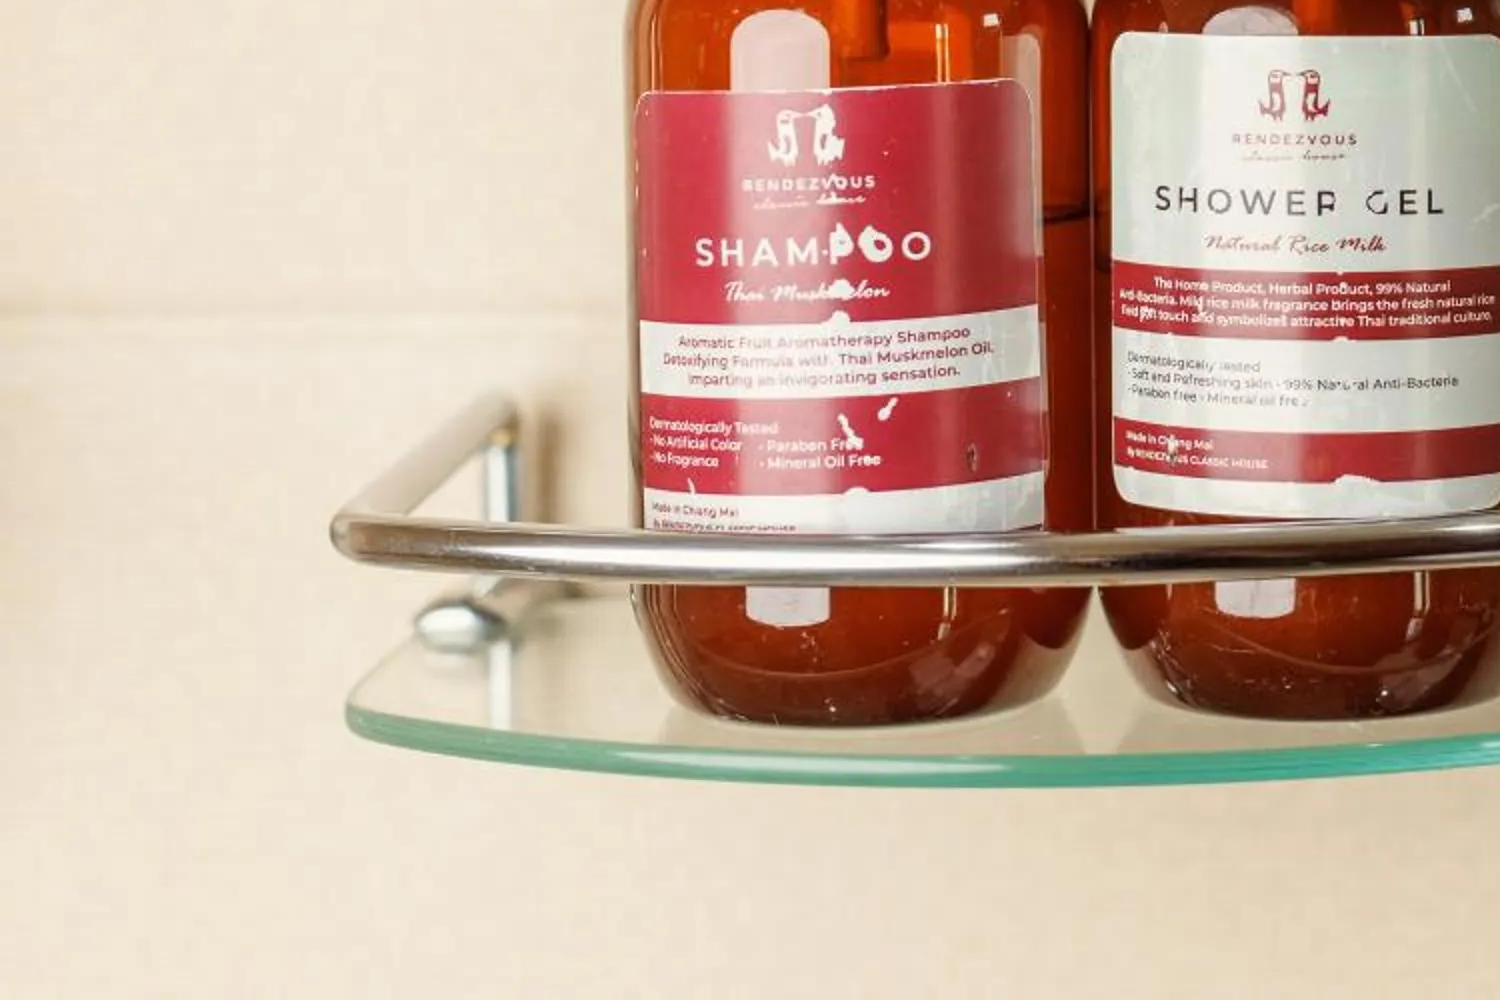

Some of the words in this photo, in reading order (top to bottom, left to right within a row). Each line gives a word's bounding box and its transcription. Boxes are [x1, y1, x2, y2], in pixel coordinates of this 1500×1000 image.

[1232, 132, 1357, 146] RENDEZVOUS
[742, 174, 876, 192] RENDEZVOUS
[1155, 185, 1337, 216] SHOWER
[1366, 188, 1444, 216] GEL
[695, 226, 932, 267] SHAMPOO
[1204, 233, 1283, 252] Natural
[1287, 233, 1331, 255] Rice
[1335, 234, 1387, 253] Milk
[724, 280, 764, 301] Thai
[773, 278, 890, 300] Muskelon
[1154, 276, 1173, 289] The
[1175, 278, 1209, 292] Home
[1269, 282, 1313, 296] Herbal
[1375, 282, 1403, 296] 99%
[1406, 279, 1451, 294] Natural
[1206, 297, 1229, 309] rice
[1231, 297, 1260, 310] milk
[1263, 298, 1329, 313] fragrance
[1376, 298, 1399, 311] the
[1401, 297, 1435, 310] fresh
[1436, 293, 1476, 308] natural
[1158, 307, 1189, 323] touch
[1291, 313, 1355, 328] attractive
[1358, 313, 1387, 327] Thai
[1388, 313, 1450, 326] traditional
[678, 335, 735, 350] Aromatic
[739, 336, 772, 349] Fruit
[777, 332, 893, 349] Aromatherapy
[897, 327, 971, 344] Shampoo
[663, 352, 729, 370] Detoxifying
[732, 355, 793, 368] Formula
[839, 352, 873, 366] Thai
[877, 345, 968, 364] Muskmelon
[1127, 350, 1215, 372] Dermatologically
[1218, 361, 1261, 373] ested
[780, 370, 877, 387] invigorating
[881, 364, 961, 382] sensation.
[1151, 371, 1171, 384] and
[1173, 373, 1241, 390] Refreshing
[1373, 374, 1460, 391] Anti-Bacteria
[1279, 395, 1308, 408] fre
[649, 416, 733, 436] Dermatologically
[734, 420, 779, 435] Tested
[710, 437, 743, 451] Color
[767, 439, 827, 452] Paraben
[1158, 435, 1192, 450] Cang
[667, 452, 719, 468] Fragrance
[767, 455, 821, 469] Mineral
[824, 455, 845, 468] Oil
[1190, 455, 1230, 469] CLASSIC
